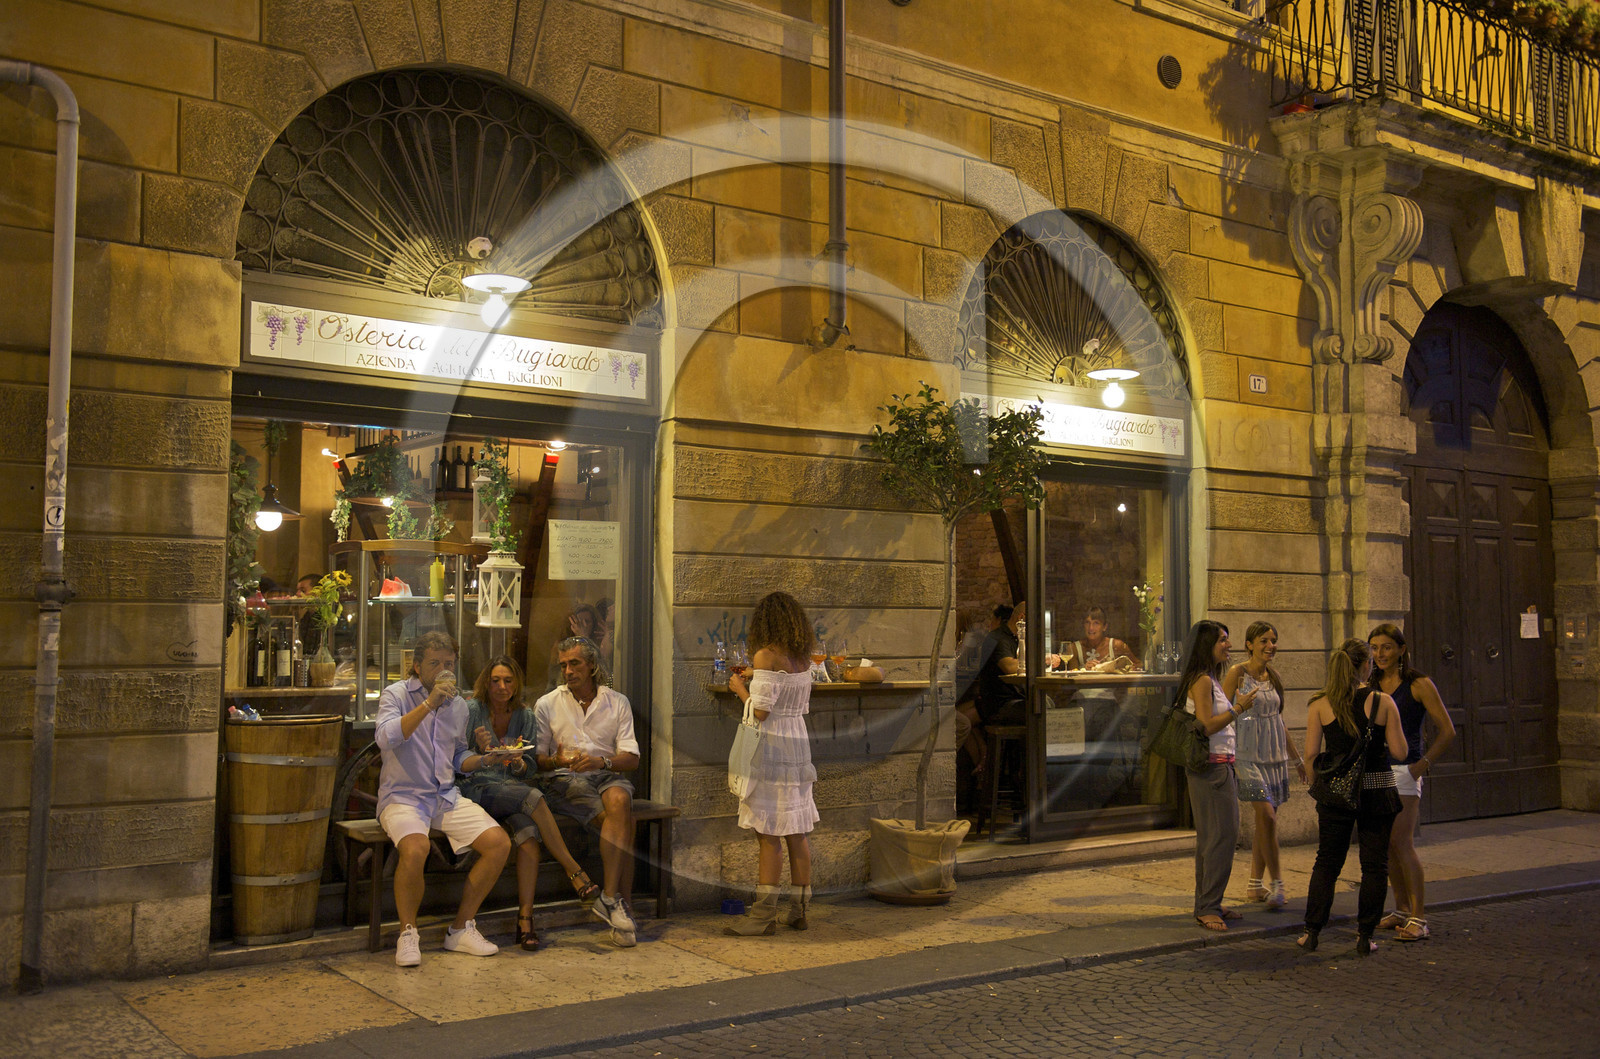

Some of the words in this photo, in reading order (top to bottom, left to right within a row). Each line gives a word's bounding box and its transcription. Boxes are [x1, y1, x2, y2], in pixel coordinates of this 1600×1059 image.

[318, 314, 428, 352] Osteria
[491, 338, 605, 373] Bugiardo
[355, 353, 417, 371] AZIENDA
[508, 370, 563, 388] BUGLIONI
